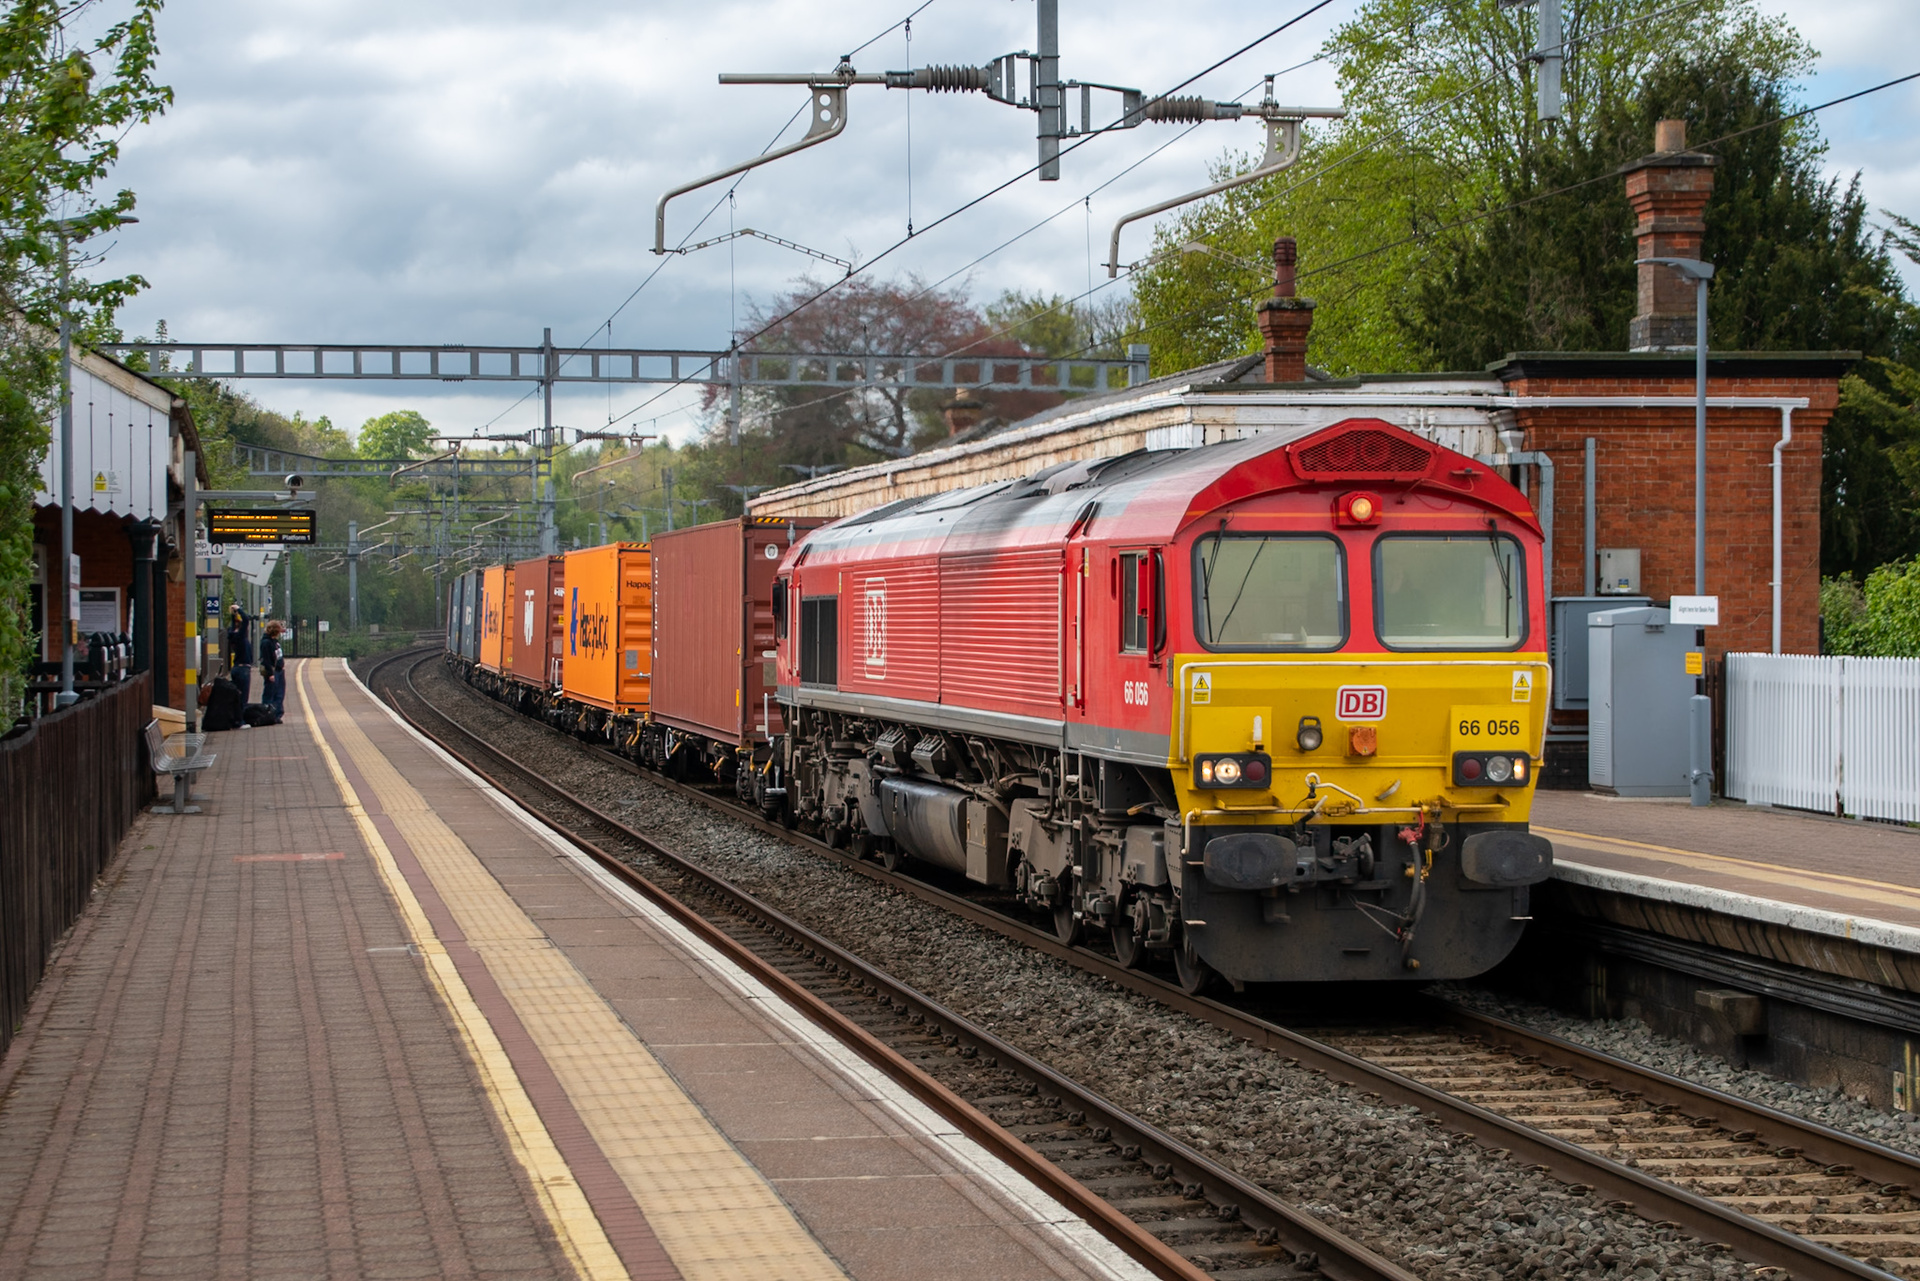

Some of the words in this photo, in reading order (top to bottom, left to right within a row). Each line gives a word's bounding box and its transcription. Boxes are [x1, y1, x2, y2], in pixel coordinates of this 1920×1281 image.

[195, 540, 207, 549] elp
[1124, 680, 1134, 704] 66
[1135, 681, 1149, 706] 056
[1344, 693, 1378, 713] DB
[1459, 720, 1480, 736] 66
[1487, 720, 1520, 736] 056
